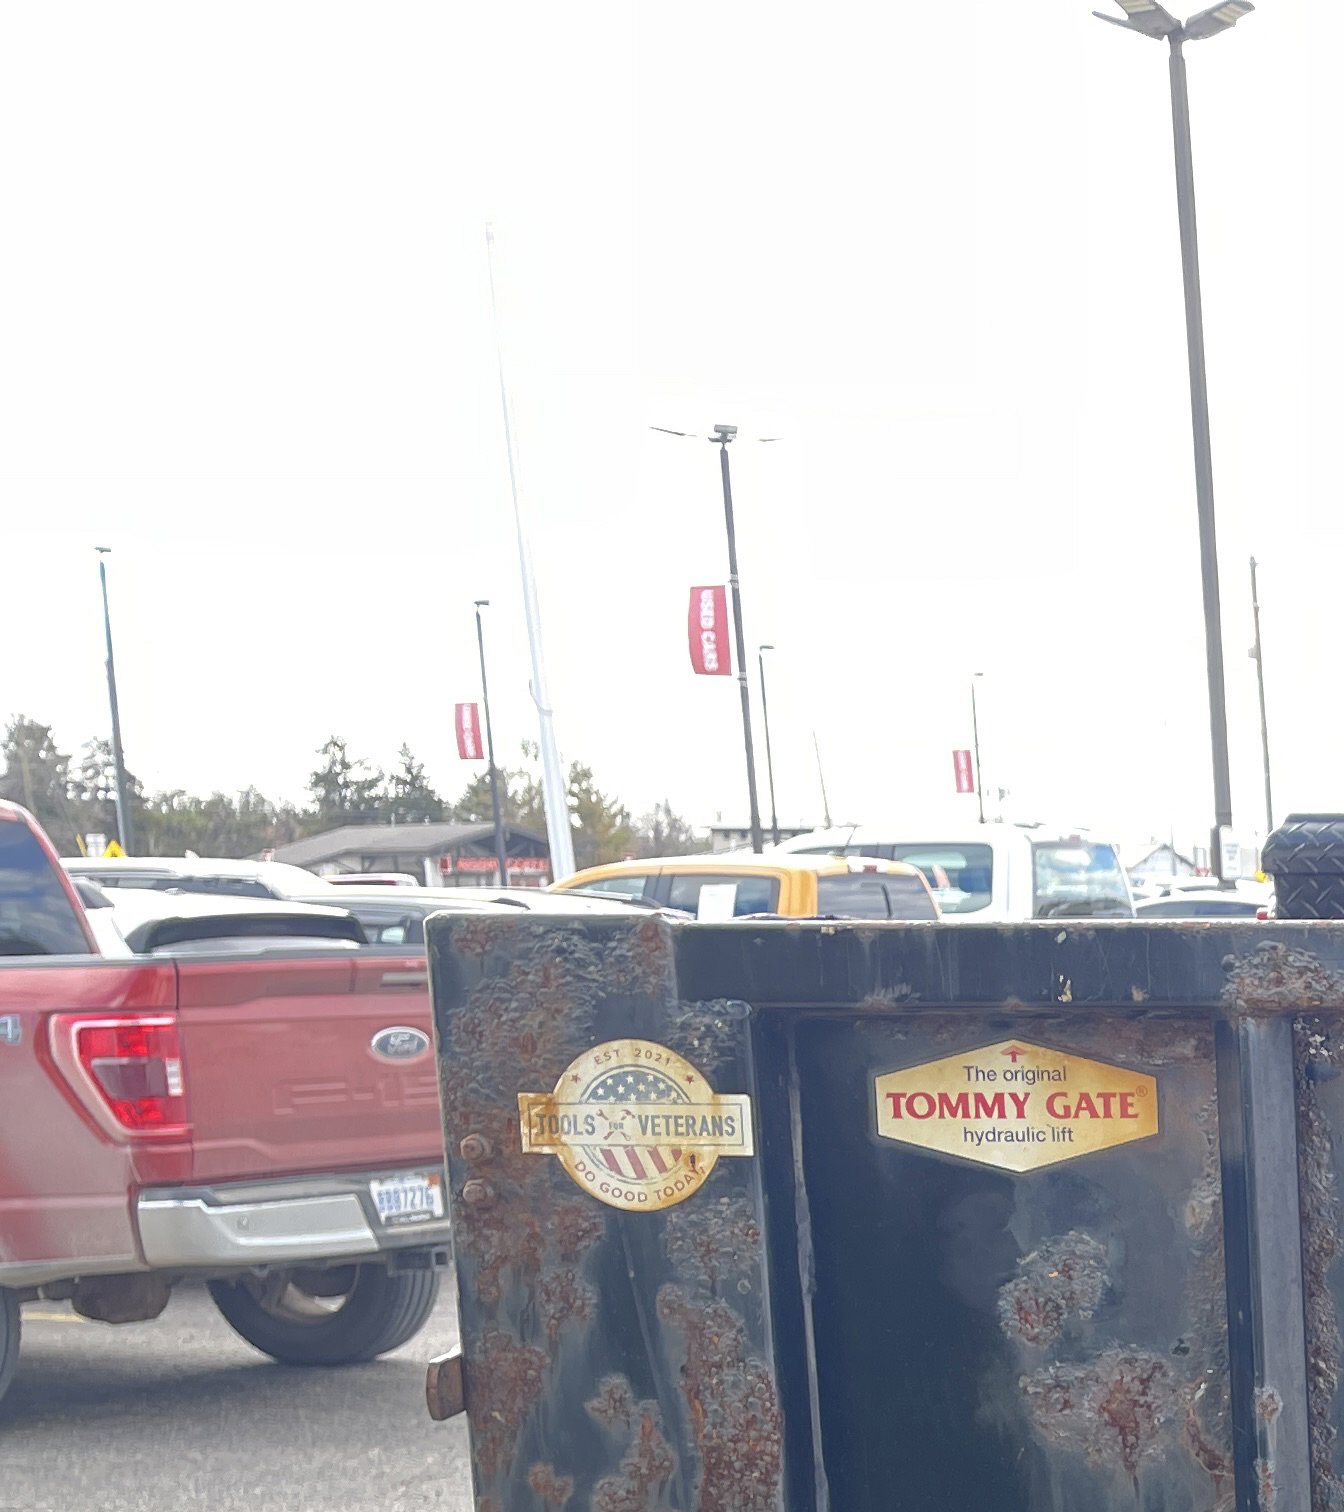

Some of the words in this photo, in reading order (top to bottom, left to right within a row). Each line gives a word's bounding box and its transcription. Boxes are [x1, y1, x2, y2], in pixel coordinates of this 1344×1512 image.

[594, 1048, 620, 1066] EST
[634, 1048, 671, 1066] 2021
[964, 1066, 997, 1082] The
[1003, 1066, 1066, 1085] original
[886, 1092, 1030, 1120] TOMMY
[536, 1114, 596, 1136] TOOLS
[608, 1122, 624, 1130] FOR
[636, 1114, 736, 1137] VETERANS
[964, 1127, 1046, 1146] hydraulic
[1052, 1127, 1074, 1142] lift
[574, 1160, 596, 1182] DO
[600, 1182, 648, 1202] GOOD
